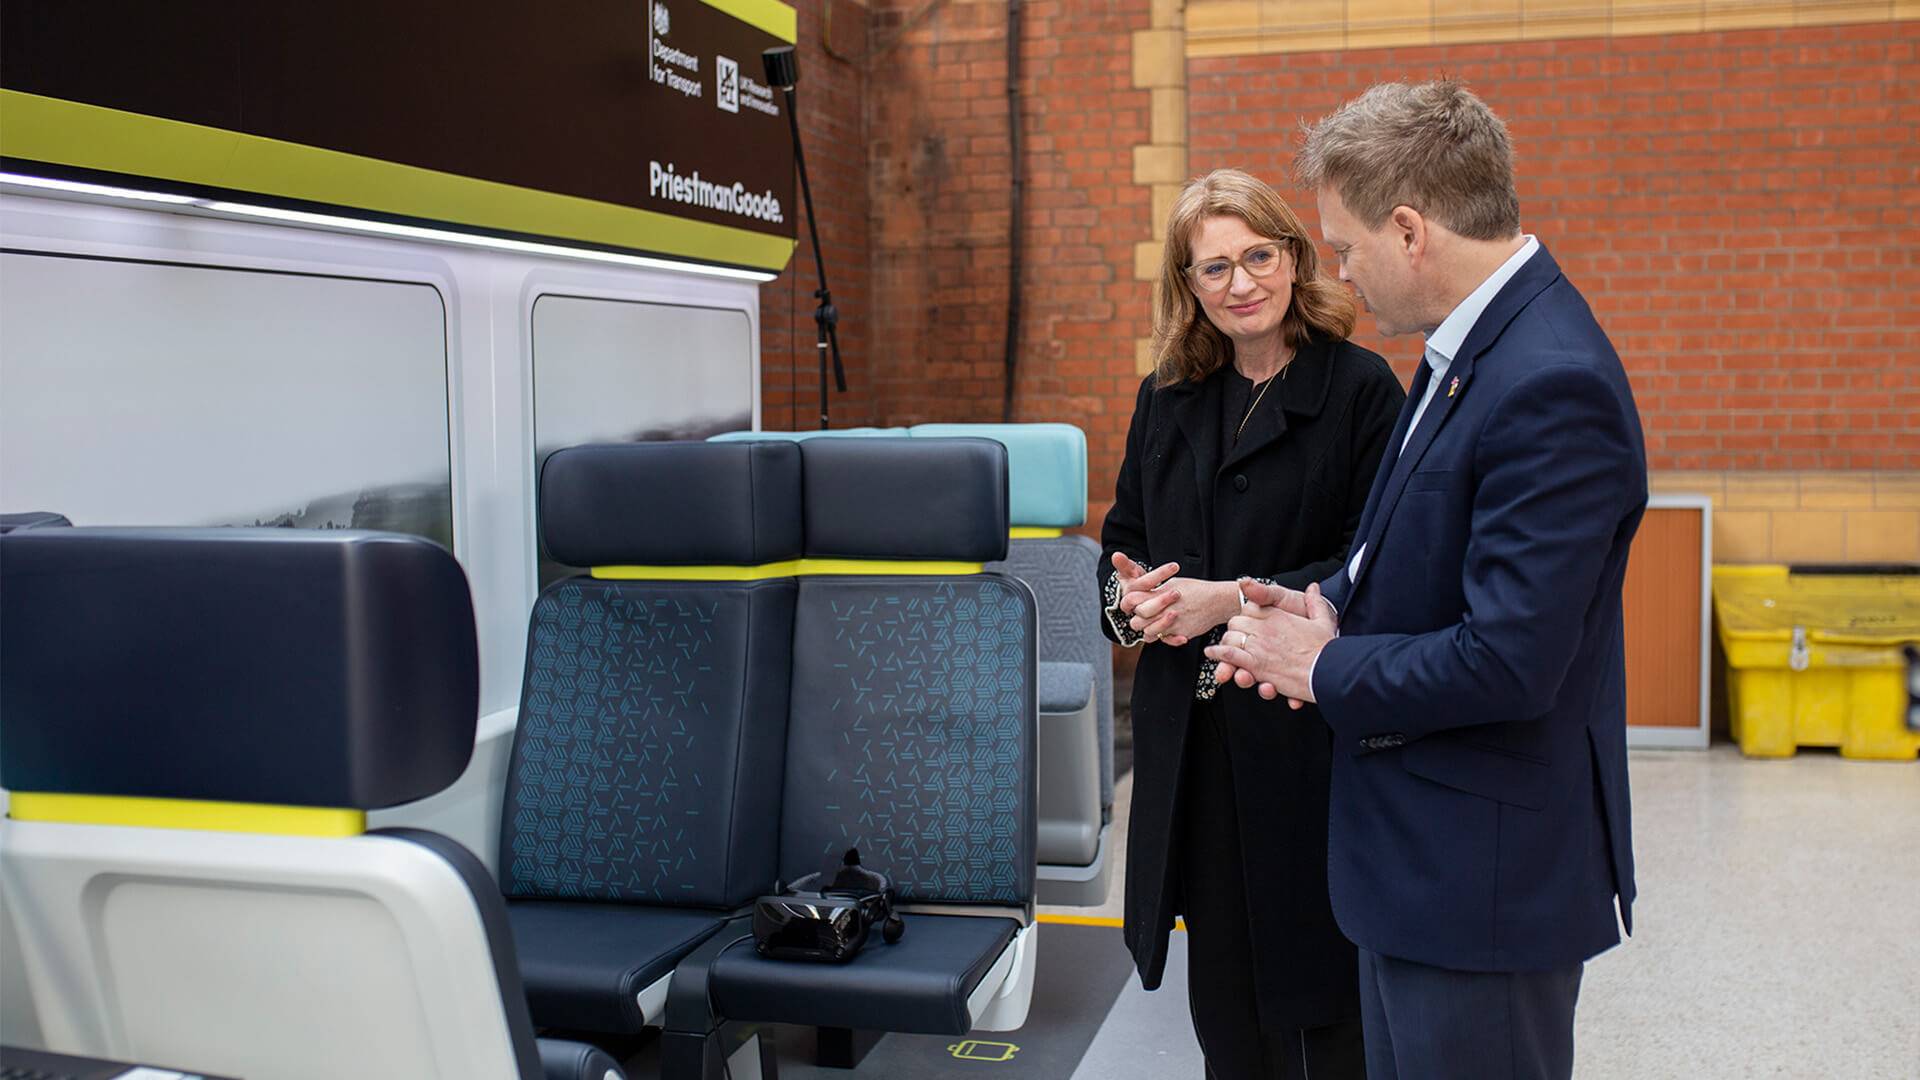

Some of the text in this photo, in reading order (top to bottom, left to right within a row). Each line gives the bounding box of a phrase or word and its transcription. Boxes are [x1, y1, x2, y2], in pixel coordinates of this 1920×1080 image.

[654, 38, 698, 72] Department
[654, 64, 666, 83] for
[666, 68, 702, 98] Transport
[649, 160, 783, 223] PriestmanGoode.
